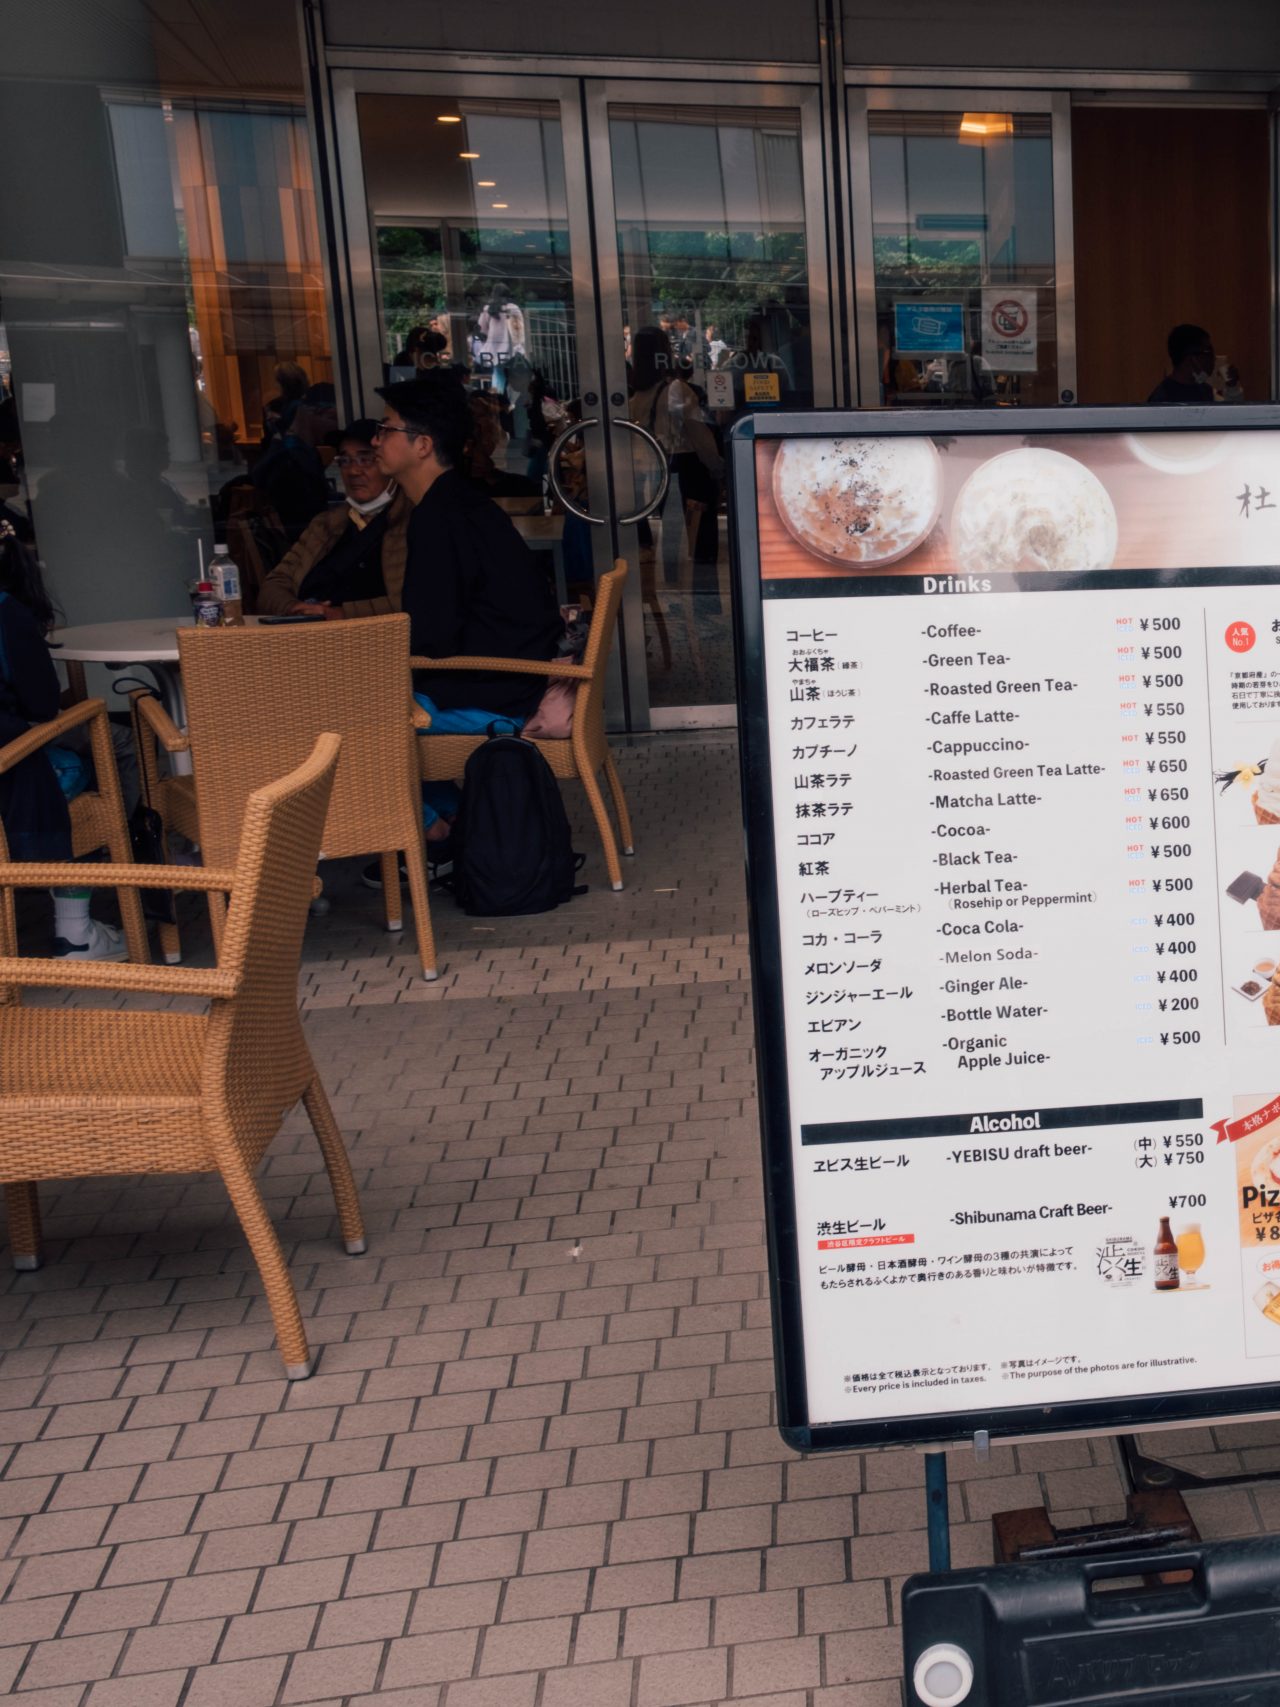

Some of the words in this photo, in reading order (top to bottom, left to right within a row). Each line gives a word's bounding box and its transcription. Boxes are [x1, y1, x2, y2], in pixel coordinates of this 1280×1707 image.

[922, 576, 992, 594] Drinks
[786, 628, 838, 642] コーヒー
[996, 680, 1041, 694] Green
[790, 714, 856, 731] カフェラテ
[792, 743, 857, 760] カプチーノ
[993, 766, 1034, 779] Green
[1036, 764, 1063, 777] Tea
[794, 773, 852, 790] 山茶ラテ
[795, 802, 854, 819] 抹茶ラテ
[797, 832, 836, 846] ココア
[798, 860, 830, 877] 紅茶
[800, 888, 879, 904] ハーブティー
[804, 958, 882, 976] メロンソーダ
[805, 986, 914, 1006] ジンジャーエール
[807, 1018, 862, 1033] エビアン
[808, 1045, 887, 1063] オーガニック
[820, 1061, 927, 1081] アップルジュース
[957, 1053, 1002, 1072] Apple
[969, 1111, 1041, 1133] Alcohol
[1013, 1144, 1051, 1160] draft
[1038, 1203, 1075, 1219] Craft
[816, 1218, 887, 1237] 渋生ビール
[1027, 1369, 1063, 1380] purpose
[1063, 1366, 1073, 1375] of
[1074, 1365, 1089, 1374] the
[1089, 1364, 1120, 1375] photos
[1121, 1362, 1135, 1370] are
[1136, 1360, 1149, 1368] for
[1149, 1356, 1198, 1367] illustrative.
[878, 1382, 901, 1393] price
[902, 1380, 910, 1389] is
[911, 1377, 949, 1388] included
[950, 1376, 959, 1385] in
[960, 1375, 986, 1384] taxes.
